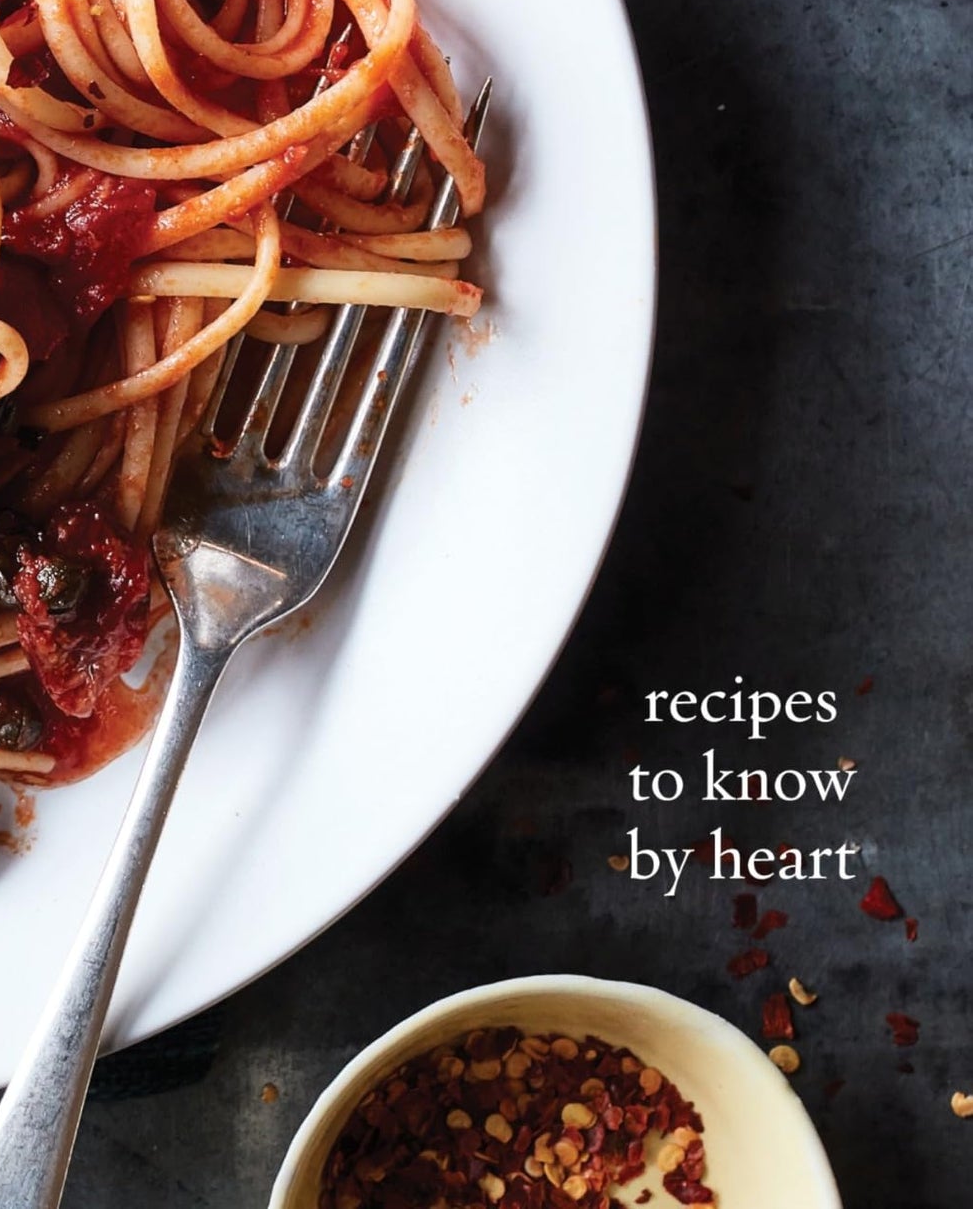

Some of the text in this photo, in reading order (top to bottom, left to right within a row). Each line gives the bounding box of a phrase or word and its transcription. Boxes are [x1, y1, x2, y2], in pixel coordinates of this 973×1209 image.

[644, 676, 837, 740] recipes
[628, 748, 858, 801] to know
[626, 827, 858, 897] by heart
